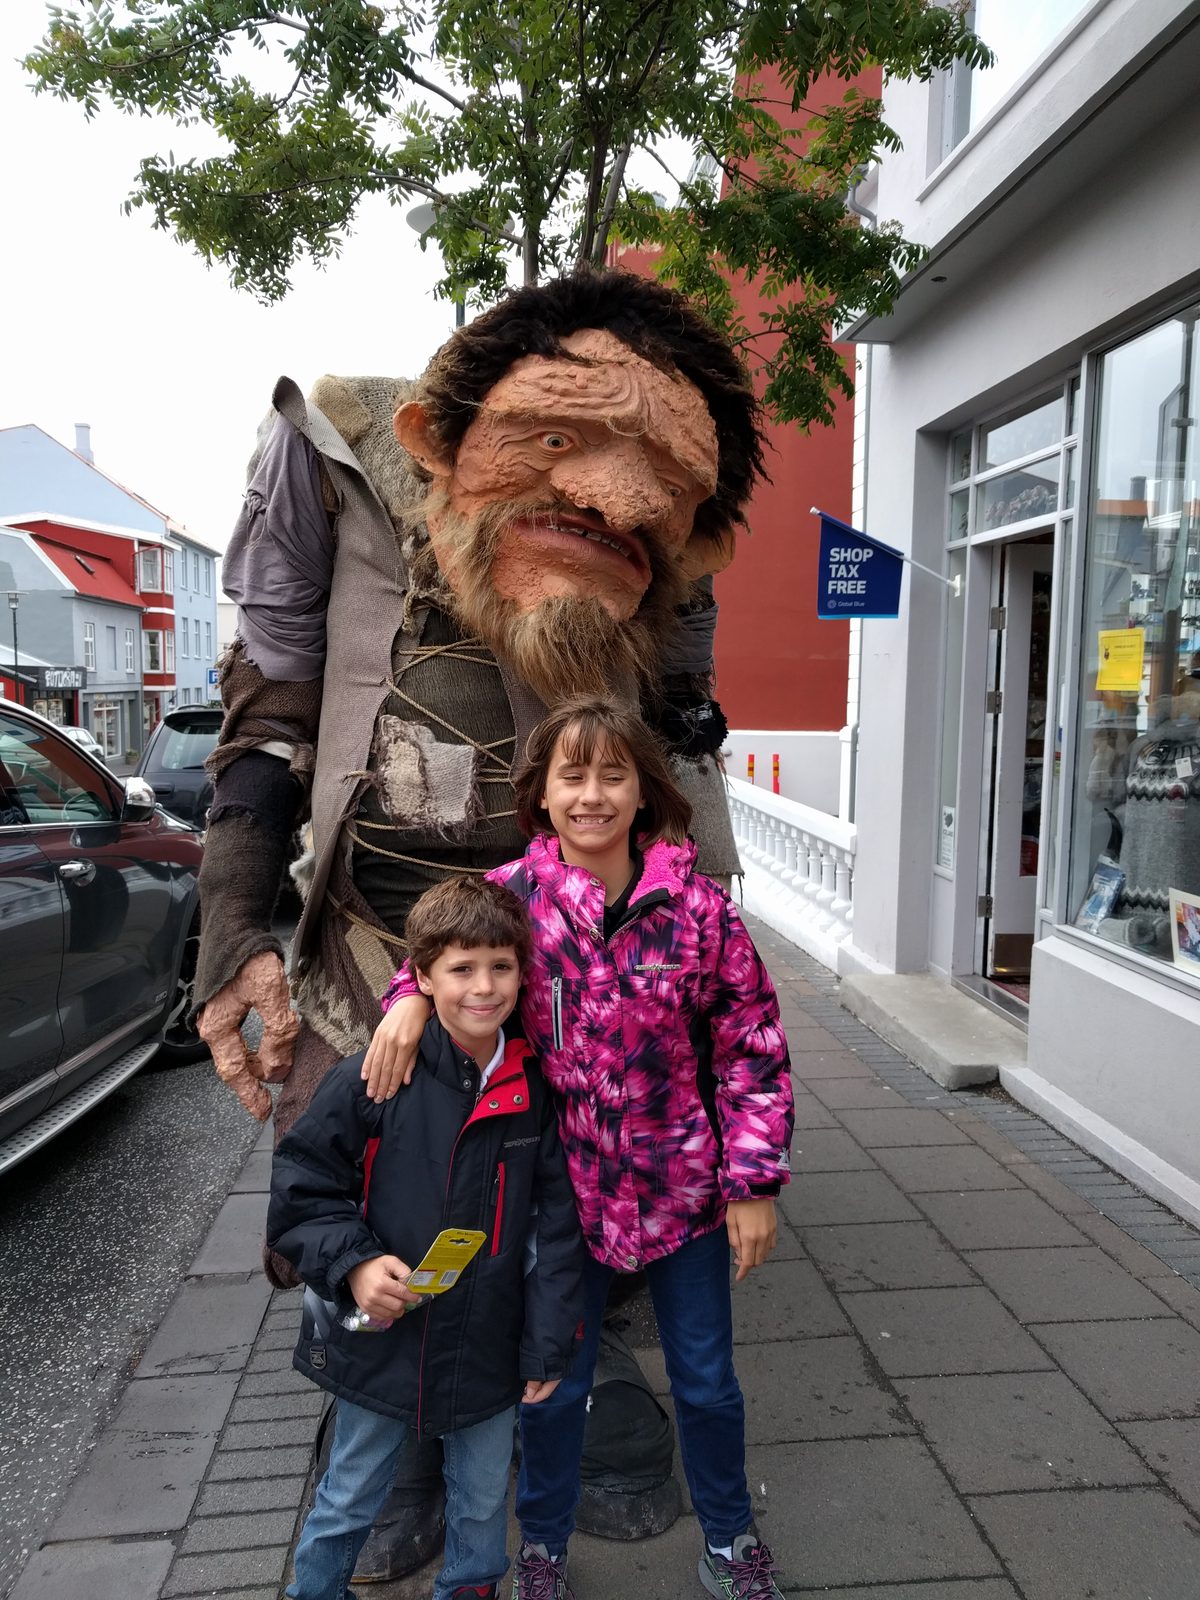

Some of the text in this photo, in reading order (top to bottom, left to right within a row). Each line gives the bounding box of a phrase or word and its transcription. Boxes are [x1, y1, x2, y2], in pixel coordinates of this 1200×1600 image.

[829, 548, 874, 562] SHOP
[829, 564, 860, 578] TAX
[827, 580, 867, 594] FREE
